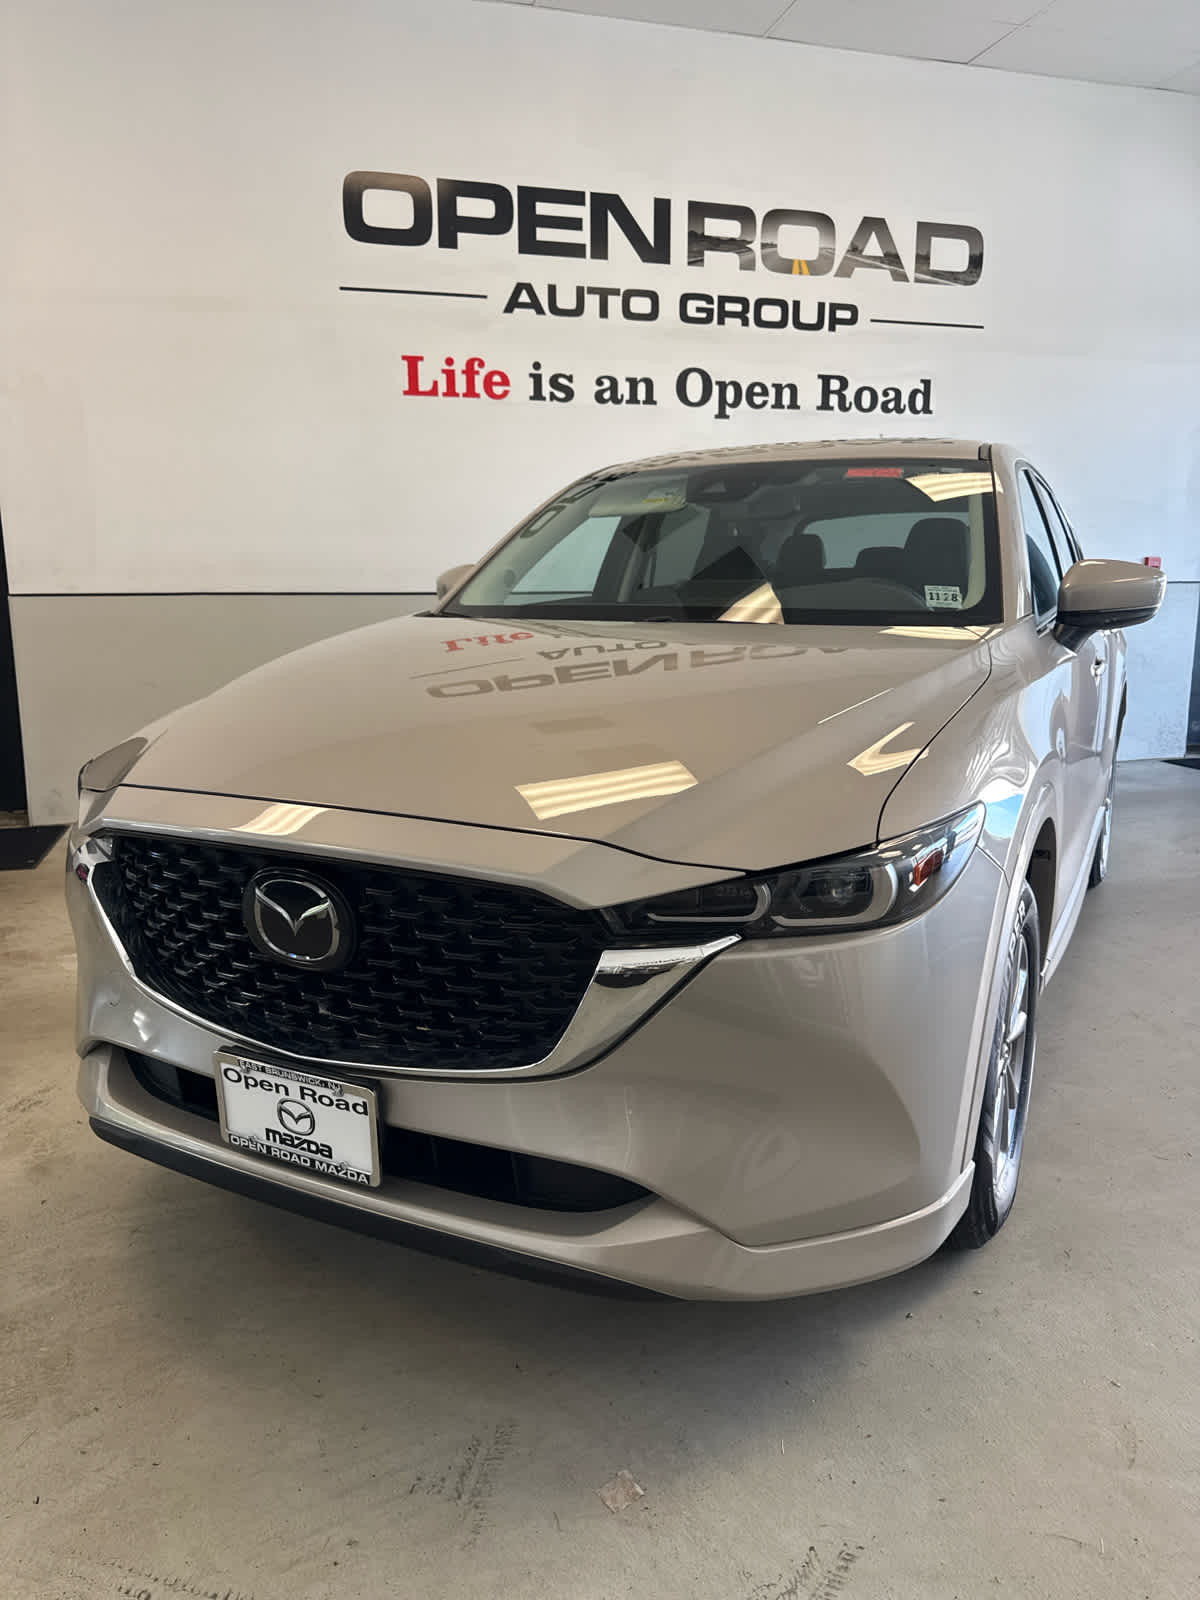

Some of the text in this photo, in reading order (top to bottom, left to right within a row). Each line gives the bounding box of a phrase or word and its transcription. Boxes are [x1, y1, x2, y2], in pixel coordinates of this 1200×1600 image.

[342, 170, 985, 287] OPEN ROAD
[503, 281, 859, 333] AUTO GROUP
[401, 355, 934, 420] Life is an Open Road
[223, 1067, 369, 1116] Open Road
[239, 1059, 264, 1073] EAST
[230, 1134, 369, 1185] OPEN ROAD MAZDA
[265, 1127, 333, 1160] mazda
